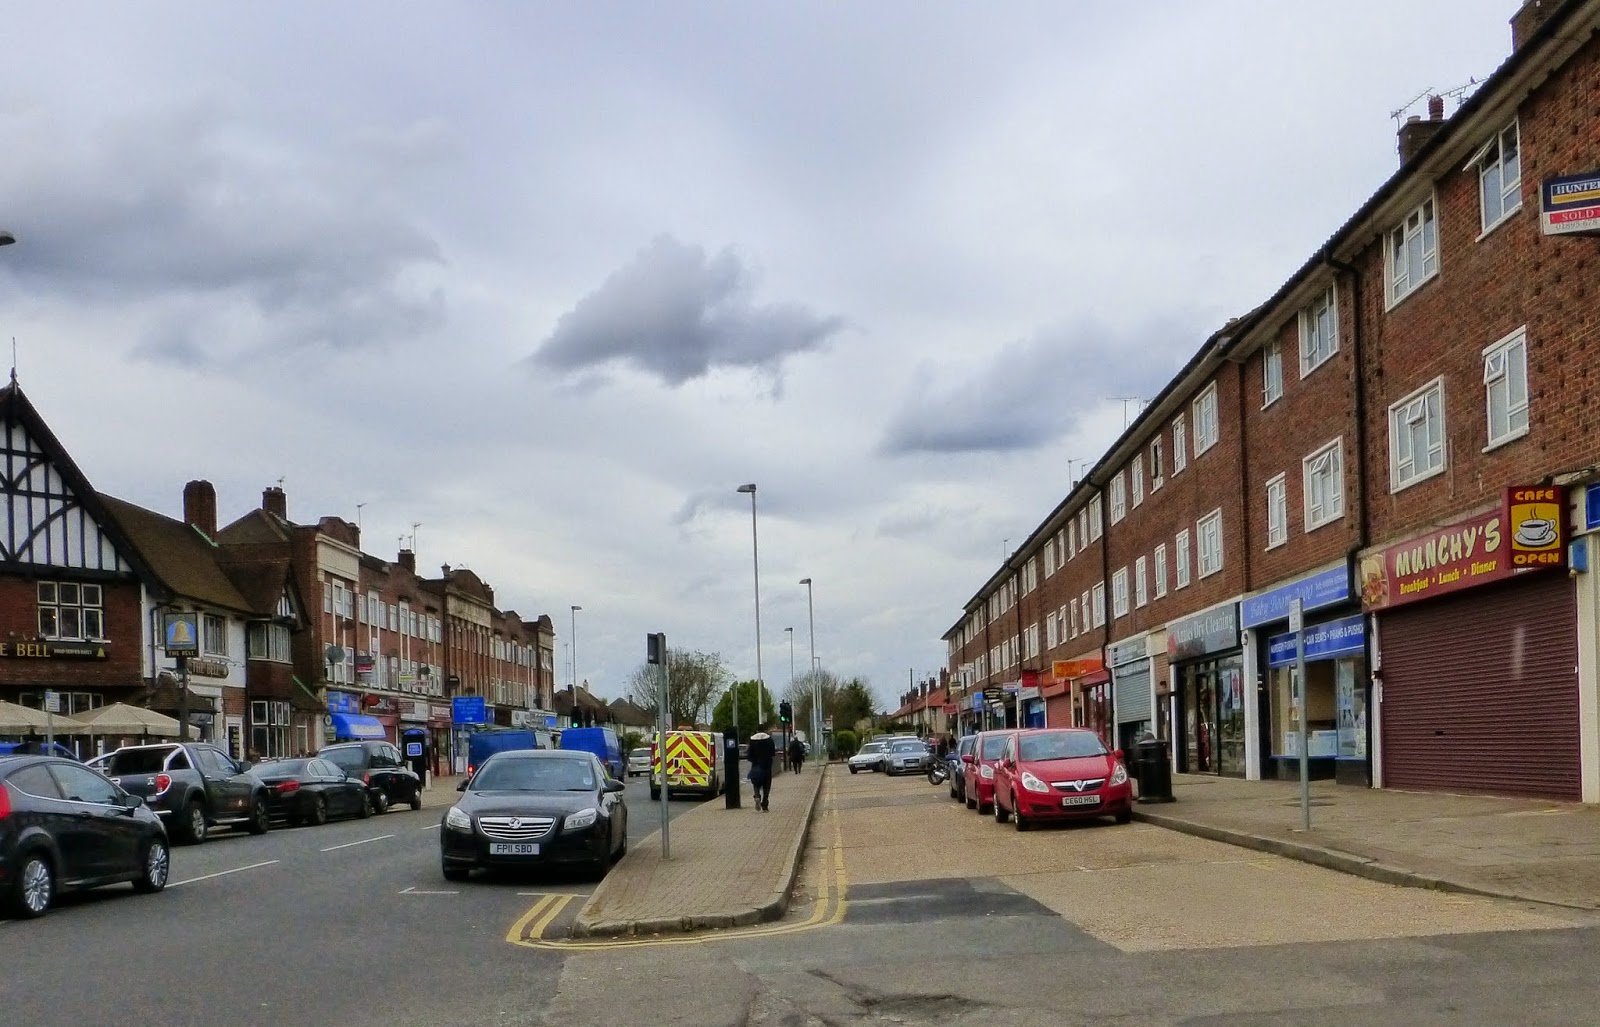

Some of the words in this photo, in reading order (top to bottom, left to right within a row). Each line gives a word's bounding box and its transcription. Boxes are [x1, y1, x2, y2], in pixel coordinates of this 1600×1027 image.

[1561, 210, 1595, 221] SOLD
[1514, 489, 1554, 501] CAFE
[1396, 517, 1501, 578] MUNCHY'S
[1513, 552, 1560, 565] OPEN
[1400, 577, 1429, 595] Breakfast
[1438, 568, 1460, 585] Lunch
[1470, 560, 1497, 576] Dinner
[1205, 611, 1233, 634] Cleaning
[1306, 634, 1315, 645] CAR
[1315, 631, 1327, 644] SEATS
[1329, 628, 1344, 640] PRAMS
[16, 643, 51, 658] BELL
[1083, 795, 1097, 803] HSL
[514, 844, 532, 853] SBO
